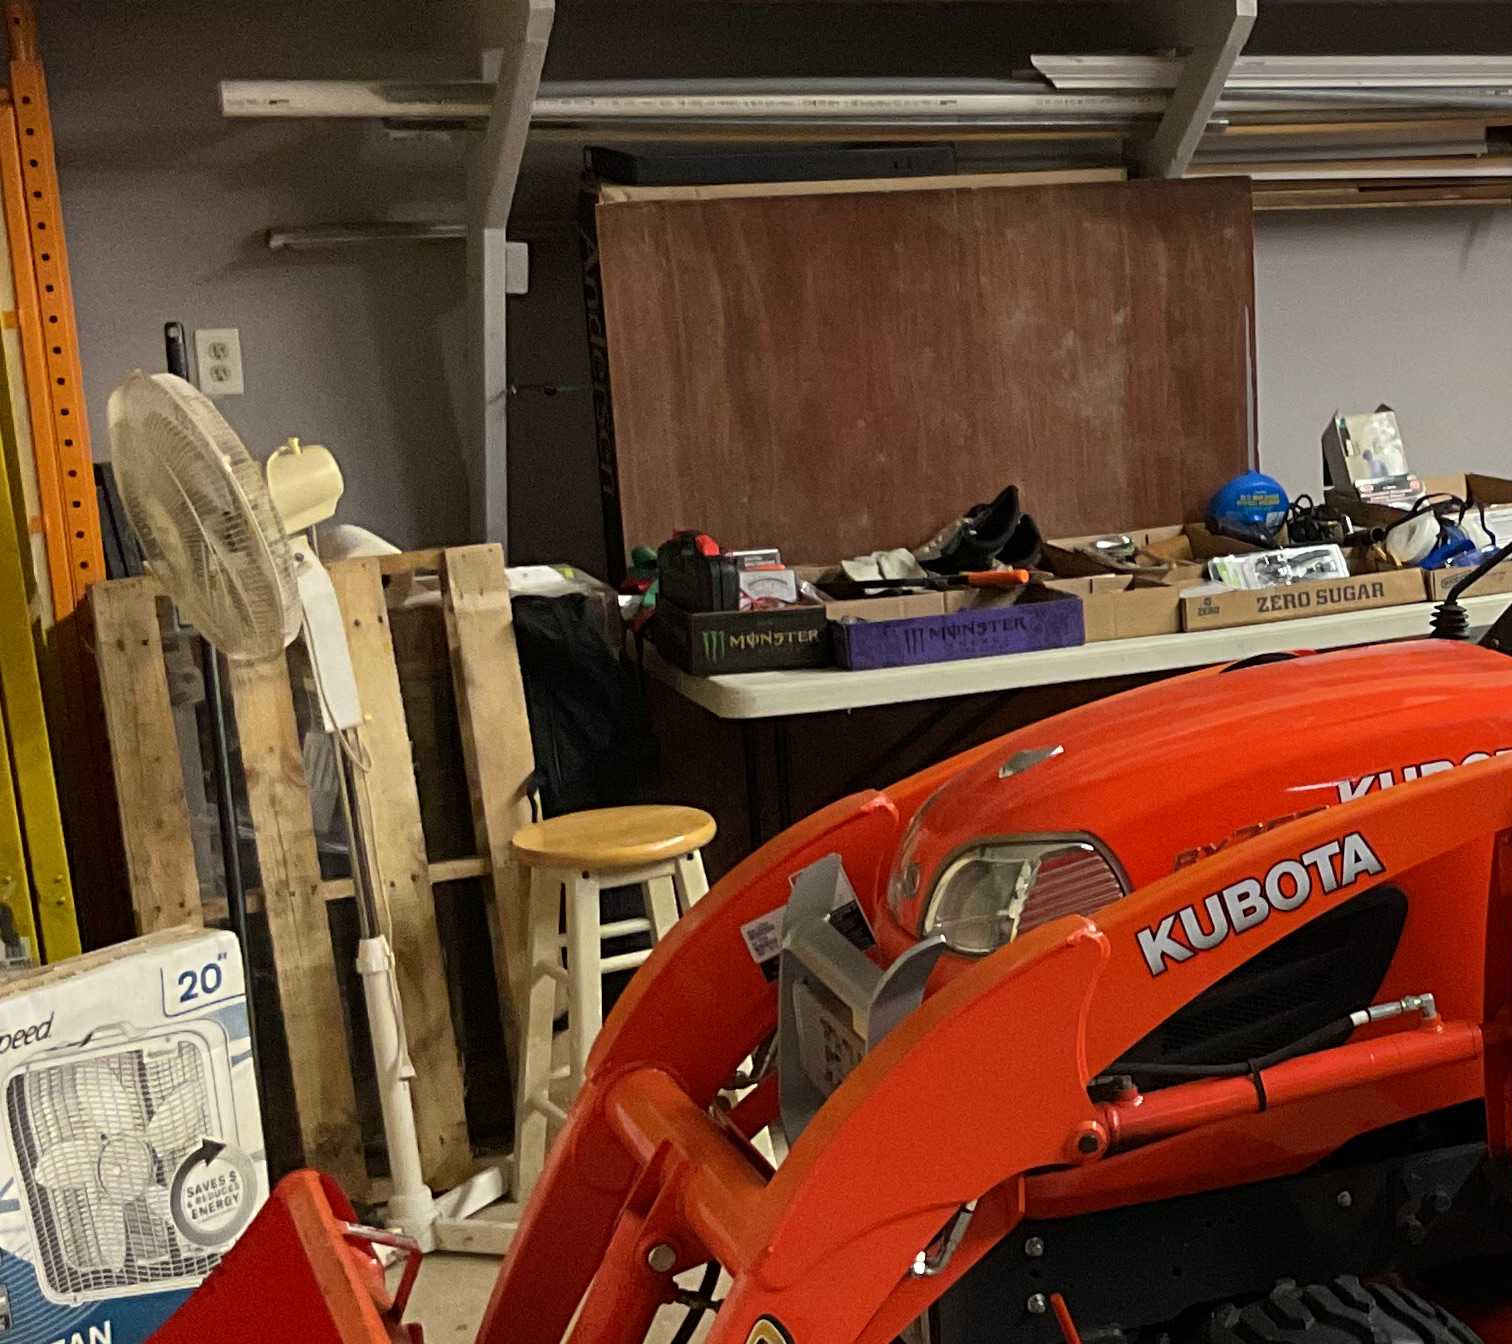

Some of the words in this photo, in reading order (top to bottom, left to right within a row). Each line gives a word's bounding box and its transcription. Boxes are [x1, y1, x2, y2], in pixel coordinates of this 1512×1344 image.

[1256, 591, 1311, 613] ZERO
[1316, 582, 1385, 605] SUGAR
[729, 630, 819, 649] MONSTER
[929, 616, 1027, 642] MONSTER
[1136, 831, 1387, 978] KUBOTA
[186, 1175, 225, 1199] SAVES
[191, 1191, 239, 1220] ENERGY
